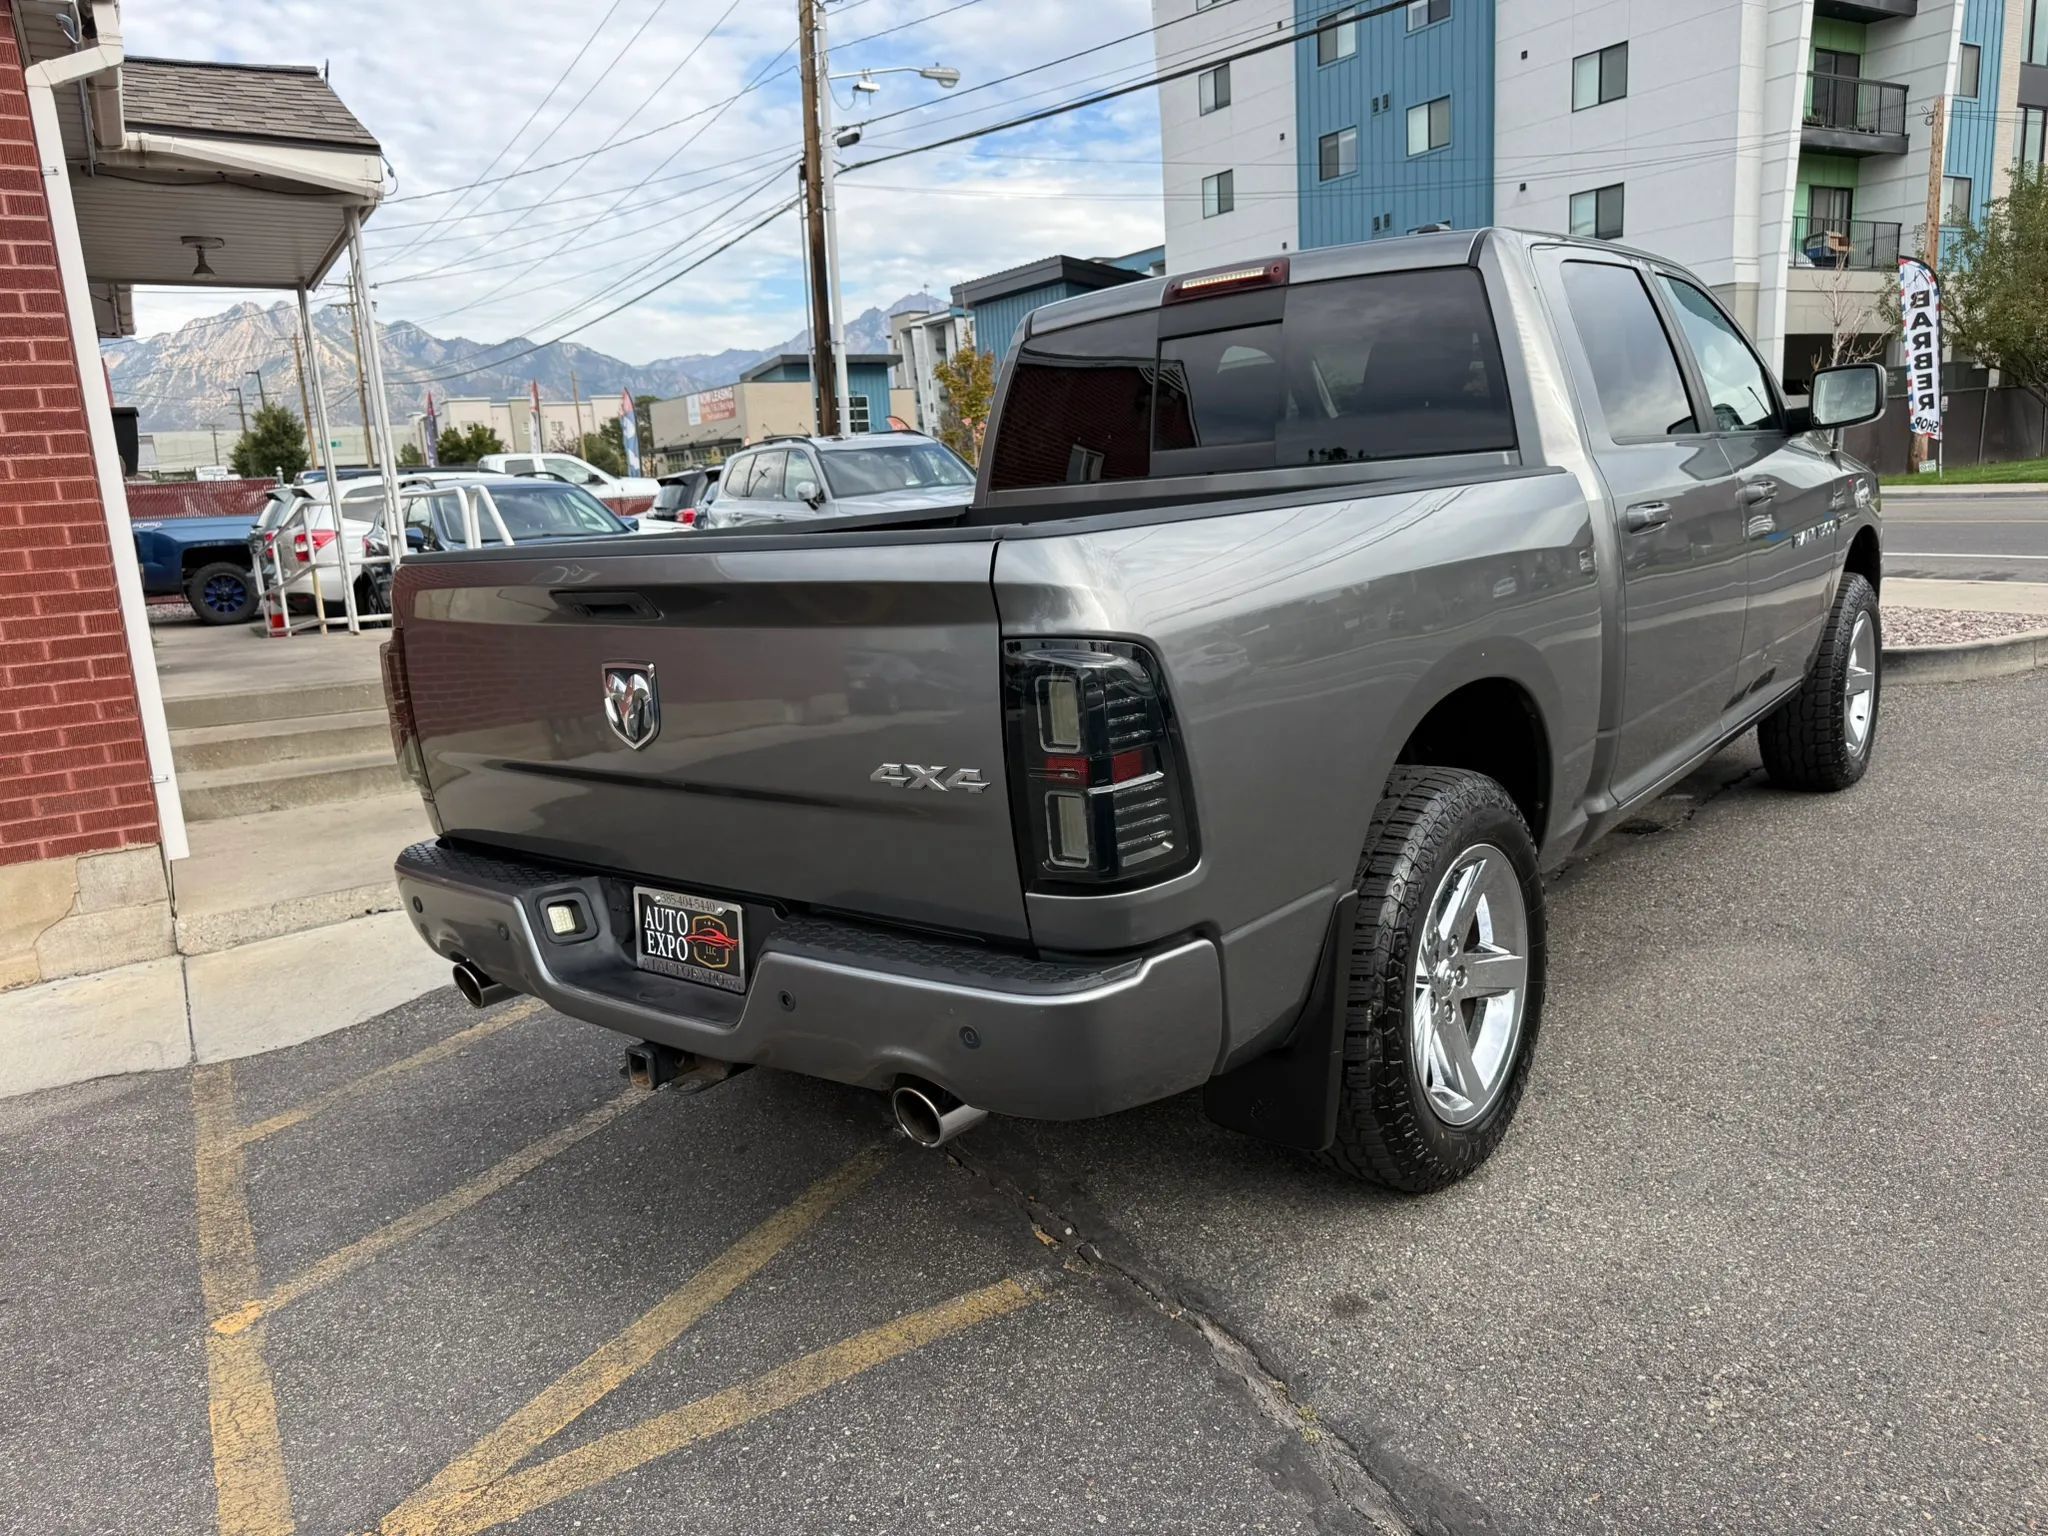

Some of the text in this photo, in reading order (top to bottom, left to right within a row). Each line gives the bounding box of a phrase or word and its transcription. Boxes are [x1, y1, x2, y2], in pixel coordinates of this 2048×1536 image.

[644, 905, 689, 936] AUTO
[646, 930, 689, 961] EXPO
[705, 946, 717, 956] LLC
